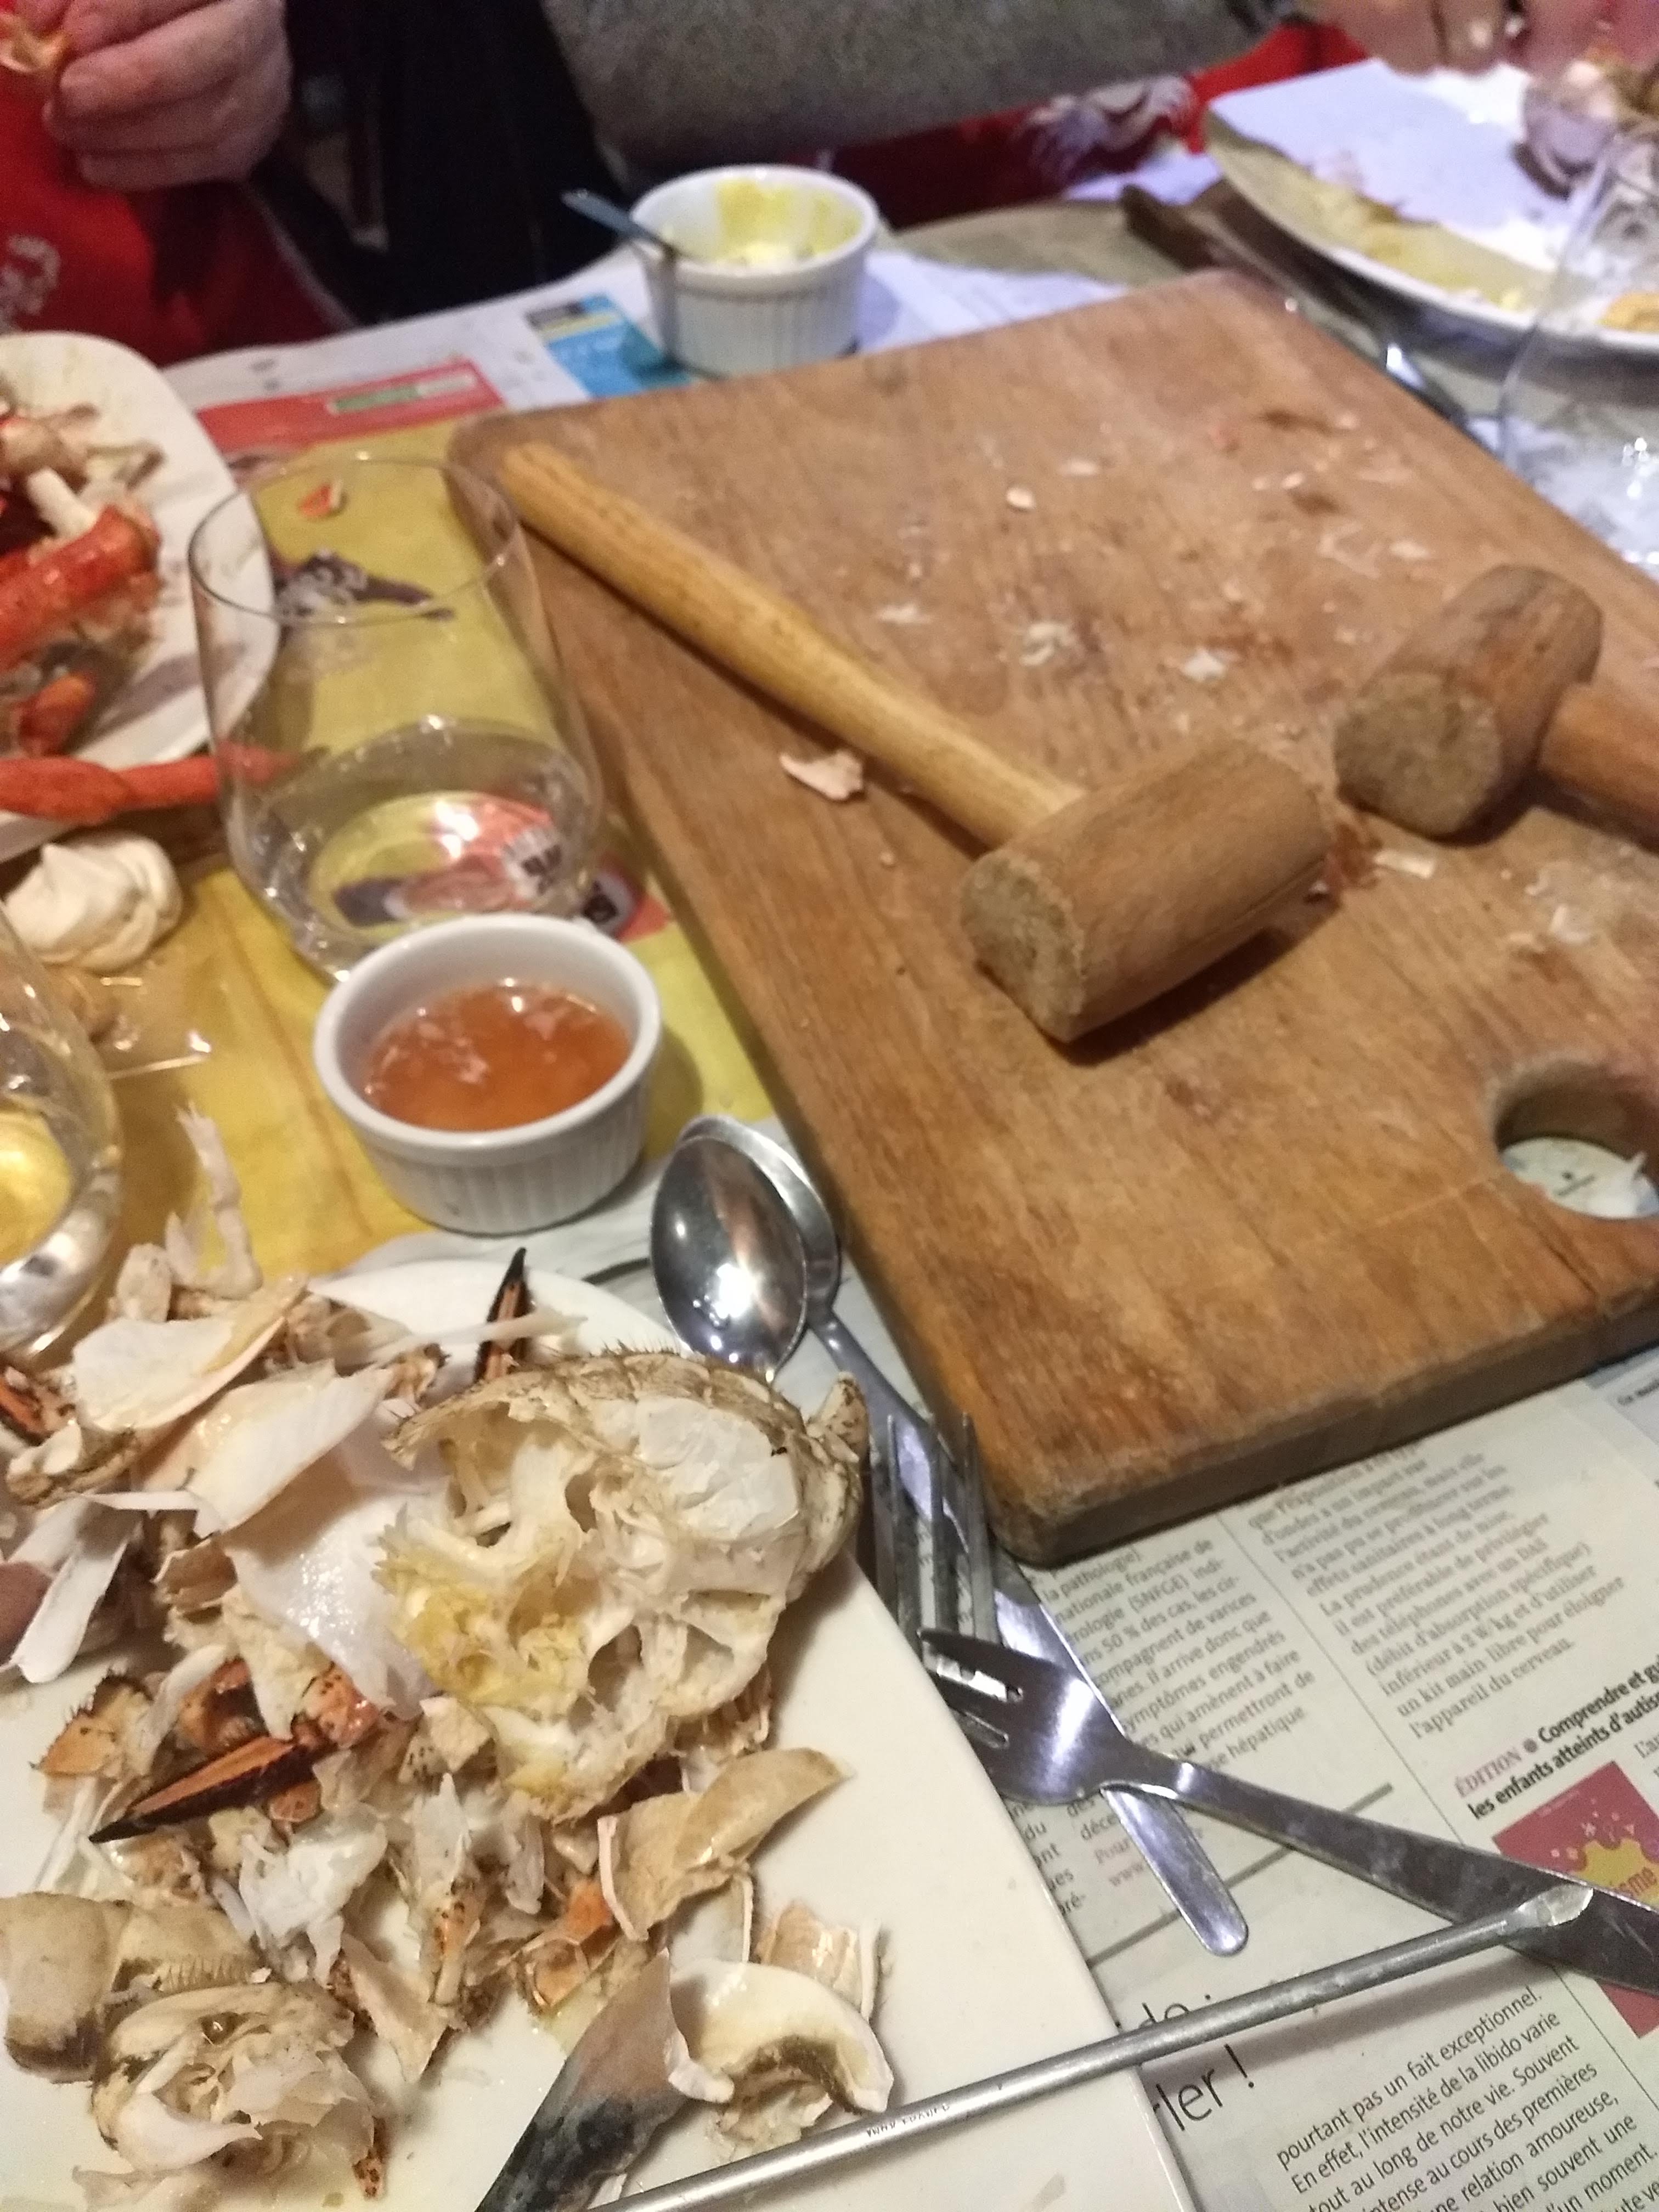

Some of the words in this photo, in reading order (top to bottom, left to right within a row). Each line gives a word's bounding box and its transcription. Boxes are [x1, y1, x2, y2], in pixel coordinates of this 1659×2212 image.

[1293, 1671, 1316, 1689] de
[1397, 1697, 1422, 1717] un
[1417, 1681, 1446, 1703] kit
[1488, 1673, 1513, 1692] du
[1537, 1686, 1630, 1743] Comprendre
[1627, 1670, 1646, 1690] et
[1466, 1795, 1496, 1821] les
[1494, 1760, 1554, 1805] enfants
[1551, 1726, 1611, 1770] atteints
[1277, 2108, 1352, 2171] pourtant
[1352, 2091, 1383, 2123] pas
[1384, 2075, 1408, 2096] un
[1407, 2051, 1440, 2081] fait
[1439, 1985, 1542, 2060] exceptionnel.
[1291, 2171, 1318, 2194] En
[1318, 2141, 1364, 2178] effet,
[1358, 2086, 1441, 2150] l'intensité
[1440, 2078, 1463, 2097] de
[1458, 2066, 1479, 2084] la
[1474, 2038, 1522, 2073] libido
[1520, 2013, 1560, 2044] varie
[1350, 2172, 1375, 2196] au
[1372, 2146, 1419, 2180] long
[1416, 2131, 1439, 2152] de
[1440, 2100, 1485, 2137] notre
[1483, 2083, 1515, 2106] vie.
[1513, 2035, 1579, 2087] Souvent
[1426, 2162, 1451, 2185] au
[1450, 2132, 1494, 2169] cours
[1493, 2114, 1523, 2140] des
[1522, 2063, 1598, 2126] premières
[1461, 2152, 1525, 2203] relation
[1526, 2091, 1619, 2158] amoureuse,
[1493, 2186, 1535, 2212] bien
[1537, 2137, 1604, 2192] souvent
[1603, 2115, 1638, 2145] une
[1584, 2142, 1658, 2202] moment.
